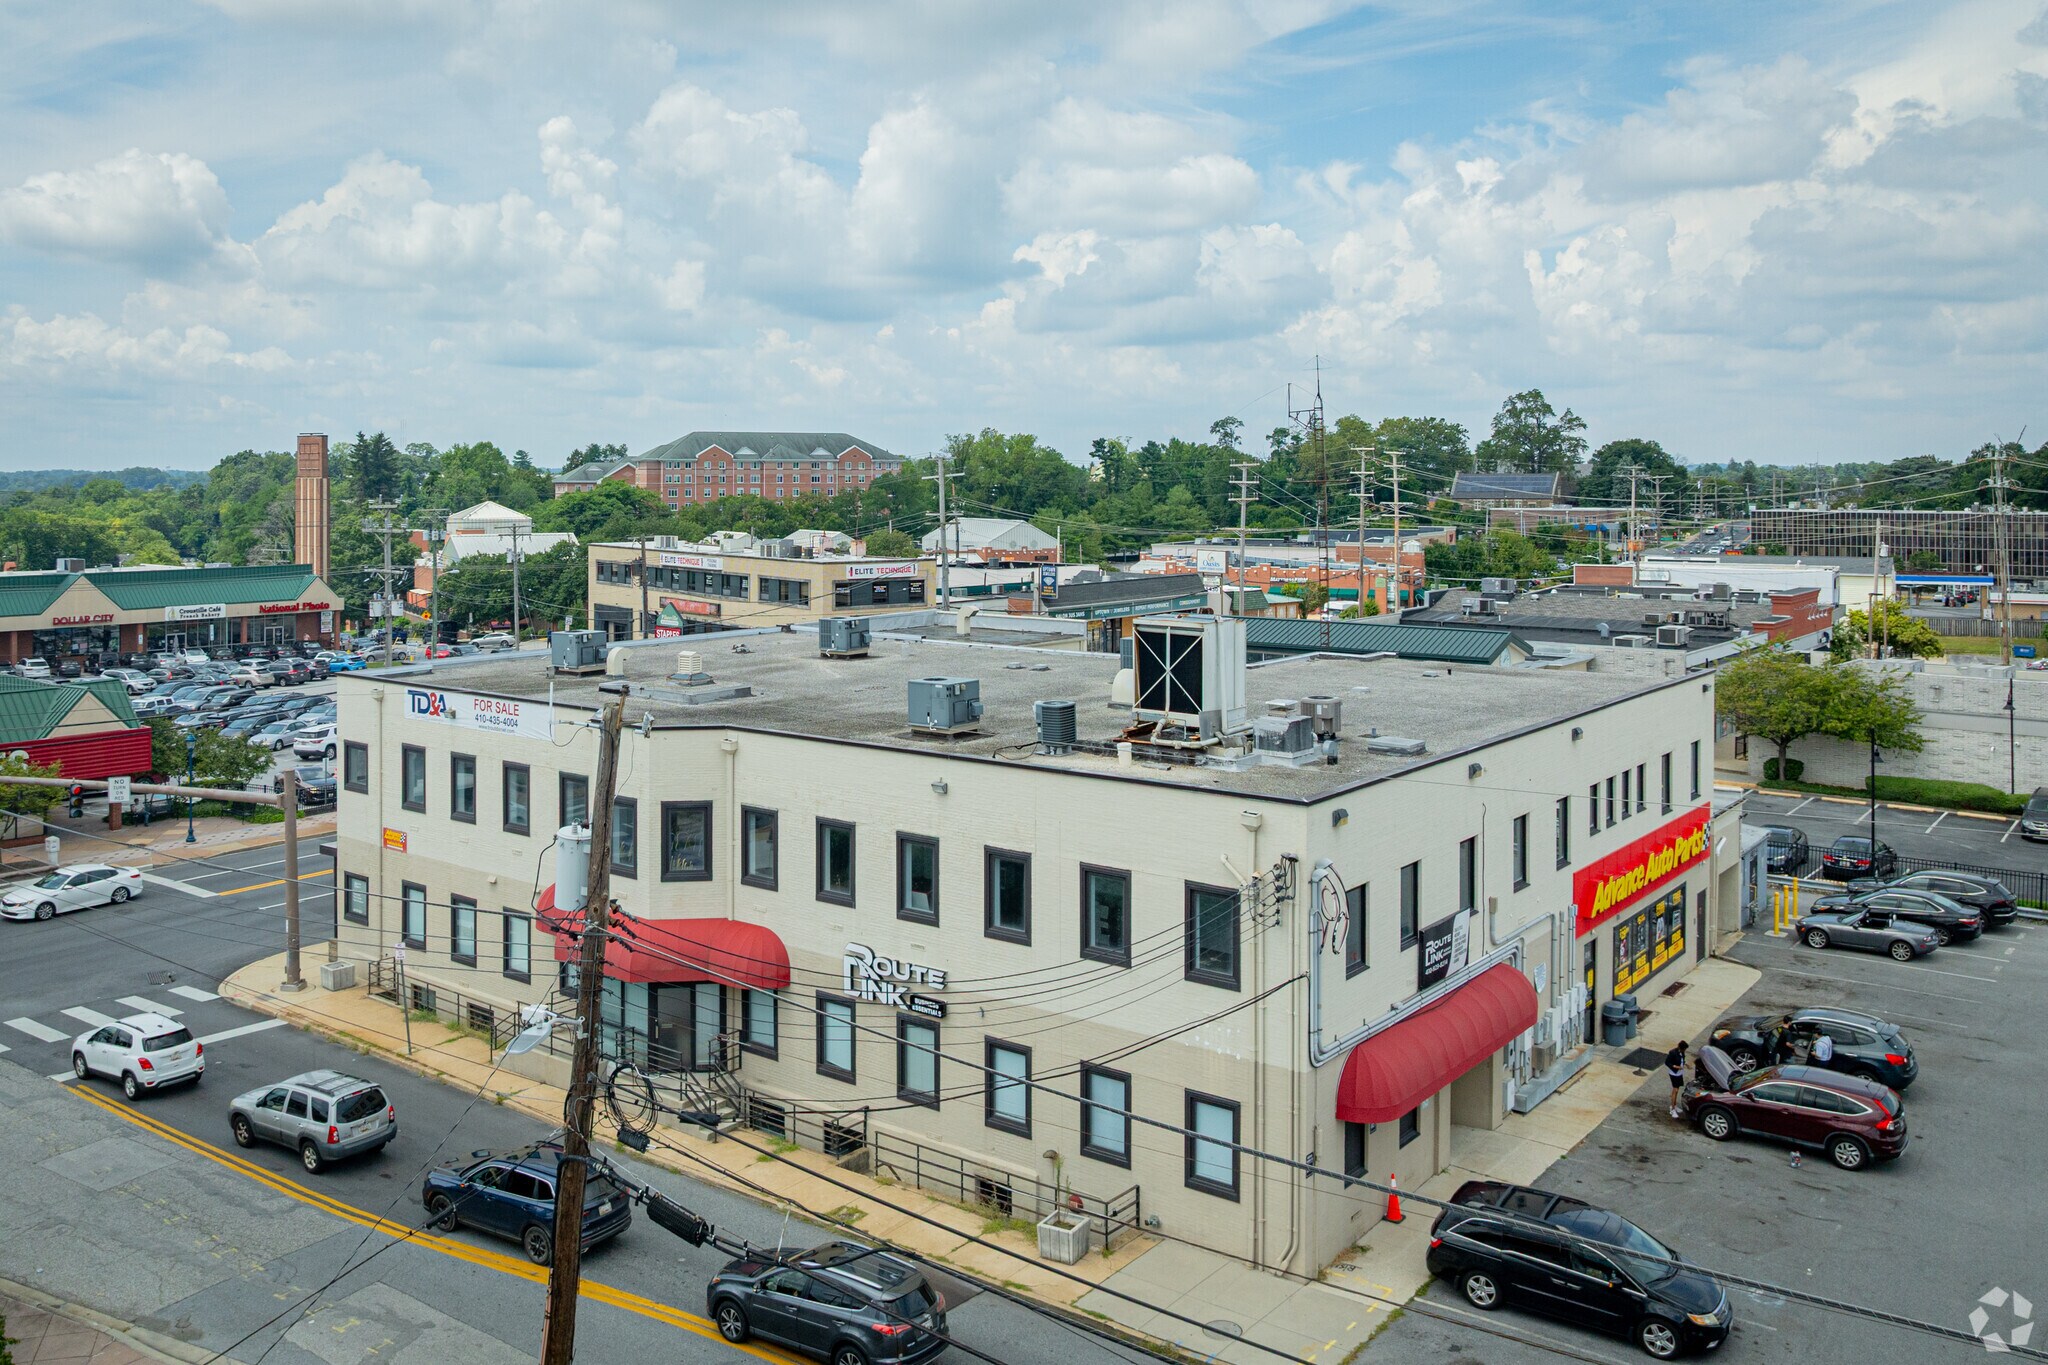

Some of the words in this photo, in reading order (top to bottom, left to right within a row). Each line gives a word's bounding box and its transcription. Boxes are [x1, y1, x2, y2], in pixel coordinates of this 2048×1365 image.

[876, 566, 912, 574] TECHNIQUE
[258, 602, 300, 614] National
[302, 602, 330, 610] Photo
[53, 615, 90, 626] DOLLAR
[93, 614, 114, 623] CITY
[656, 629, 680, 638] STAPLES
[474, 698, 493, 712] FOR
[495, 701, 520, 716] SALE
[474, 714, 518, 728] 410-435-4004
[1590, 864, 1645, 918] Advance
[1644, 845, 1674, 886] Auto
[1426, 934, 1452, 956] ROUTE
[1426, 946, 1444, 967] LINK
[844, 942, 947, 991] ROUTE
[844, 954, 909, 1011] LINK
[912, 1004, 942, 1018] ESSENTIALS
